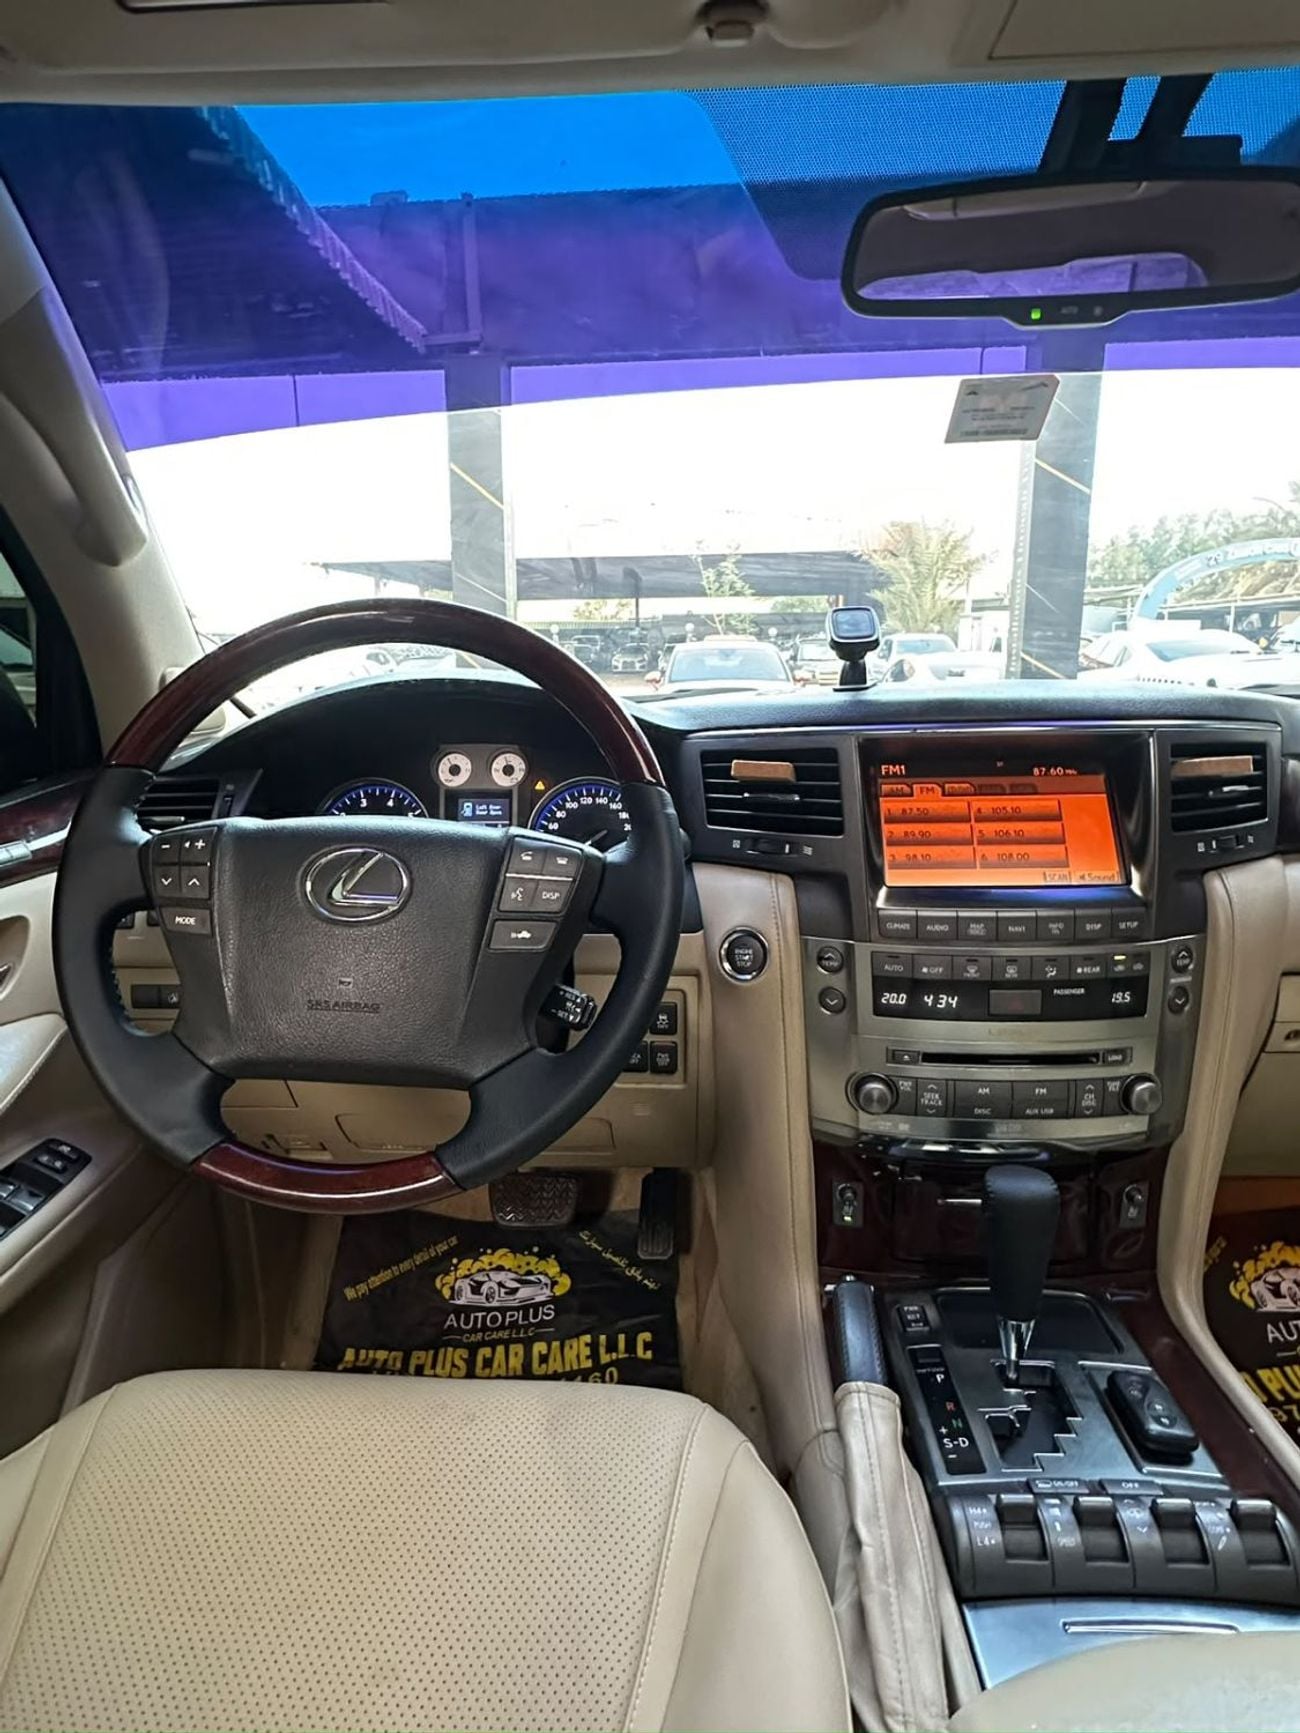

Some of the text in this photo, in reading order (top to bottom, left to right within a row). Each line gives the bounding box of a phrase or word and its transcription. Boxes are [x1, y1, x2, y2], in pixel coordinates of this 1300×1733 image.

[880, 765, 906, 776] FM1
[1033, 767, 1064, 776] 87.60
[360, 798, 367, 807] 3
[386, 798, 394, 807] 4
[579, 797, 593, 805] 120
[595, 797, 608, 805] 140
[609, 802, 622, 810] 160
[991, 805, 1022, 815] 105.10
[555, 810, 567, 819] 80
[901, 806, 929, 816] 87.50
[548, 822, 559, 830] 60
[903, 829, 932, 838] 89.90
[994, 828, 1025, 838] 106.10
[997, 852, 1030, 861] 108.00
[1087, 872, 1116, 880] Sound
[174, 915, 196, 926] MODE
[884, 964, 904, 973] AUTO
[1083, 966, 1100, 974] REAR
[1053, 987, 1085, 995] PASSENGER
[881, 993, 907, 1005] 20.0
[1035, 1087, 1047, 1096] FM
[1025, 1107, 1039, 1115] AUX
[444, 1304, 556, 1329] AUTO PLUS
[463, 1333, 482, 1343] CAR
[484, 1330, 511, 1340] CARE
[337, 1347, 404, 1371] AUTO
[408, 1346, 469, 1378] PLUS
[475, 1343, 525, 1378] CAR
[532, 1334, 592, 1375] CARE
[935, 1374, 945, 1384] P
[946, 1401, 955, 1411] R
[952, 1418, 963, 1428] N
